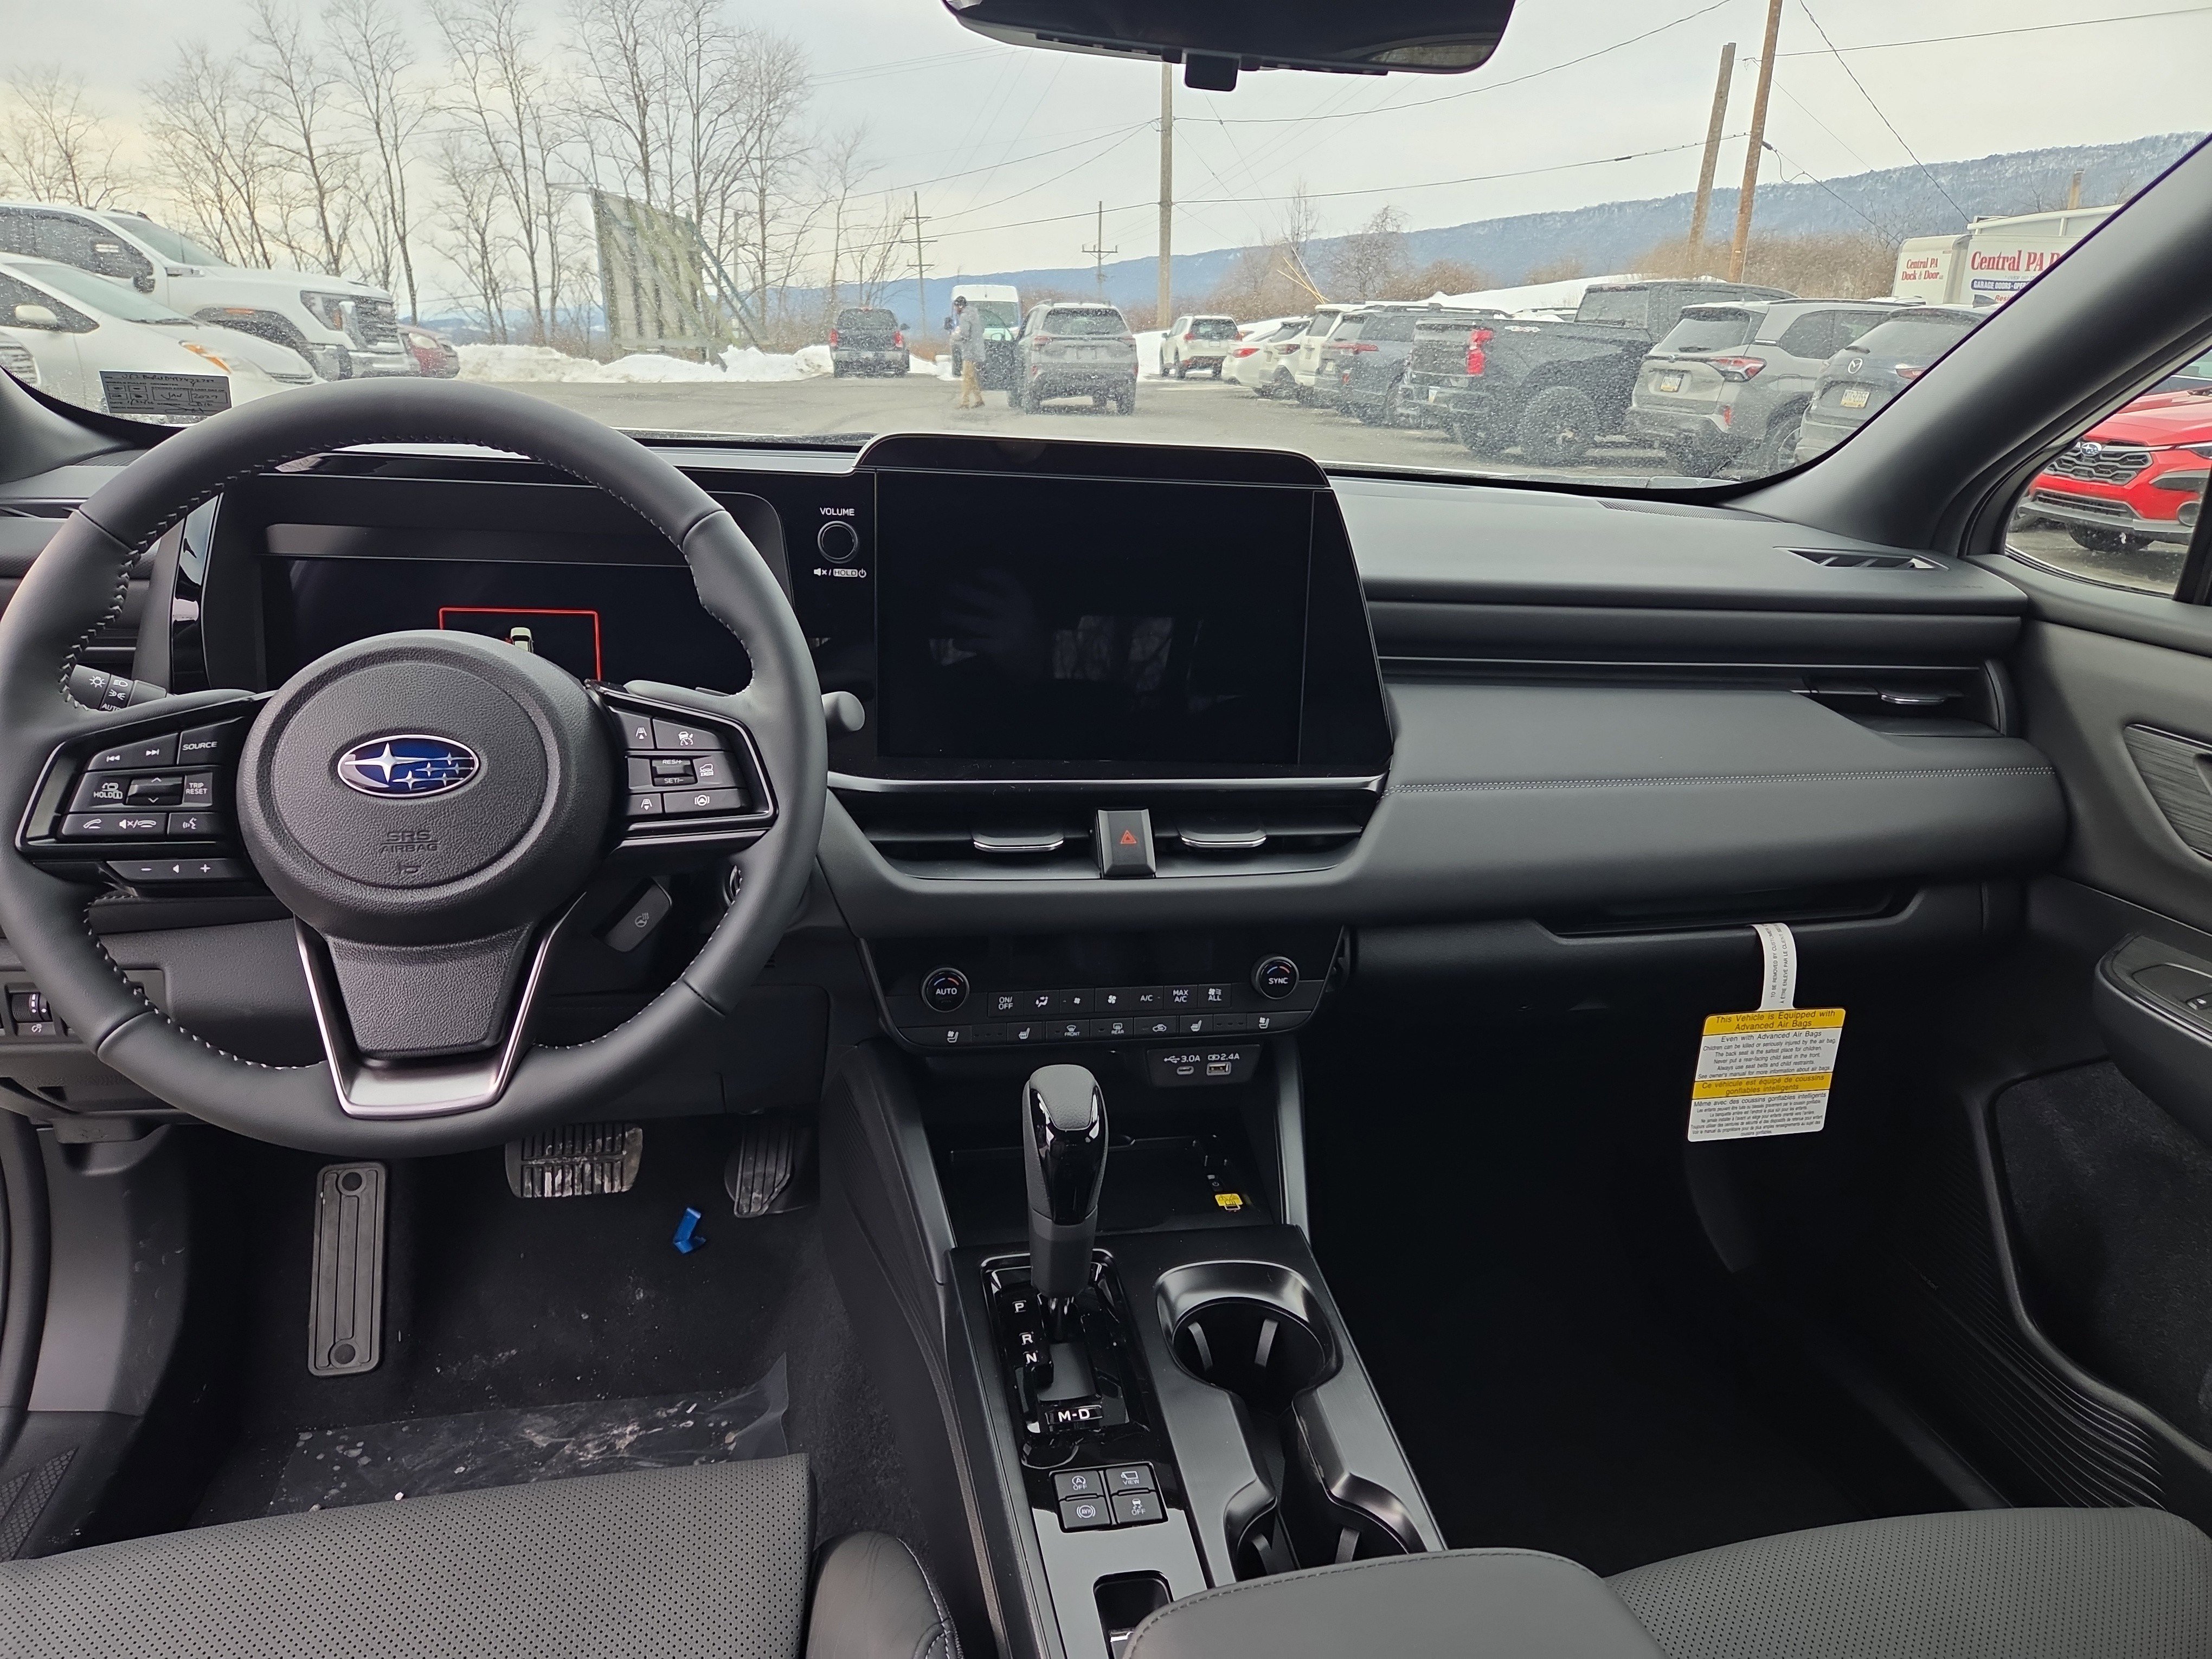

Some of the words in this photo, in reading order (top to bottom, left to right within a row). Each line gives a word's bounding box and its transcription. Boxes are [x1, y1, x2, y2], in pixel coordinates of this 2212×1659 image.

[1906, 258, 1928, 268] Central
[1971, 250, 2022, 271] Central
[2025, 252, 2044, 272] PA
[1901, 270, 1917, 280] Dock
[1924, 271, 1939, 279] Door
[1973, 280, 1994, 289] GARAGE
[820, 507, 855, 516] VOLUME
[182, 741, 218, 751] SOURCE
[387, 831, 433, 841] SRS
[381, 844, 438, 853] AIRBAG
[936, 987, 957, 995] AUTO
[1736, 1014, 1764, 1023] Vehicle
[1778, 1011, 1816, 1020] Equipped
[1735, 1022, 1774, 1031] Advanced
[1792, 1019, 1812, 1028] Bags
[1757, 1031, 1790, 1040] Advanced
[1181, 1054, 1200, 1063] 3.0A
[1726, 1086, 1760, 1096] gonflables
[1763, 1084, 1799, 1092] intelligents
[1768, 1094, 1796, 1103] gonflables
[1797, 1091, 1827, 1100] intelligents
[1014, 1302, 1024, 1313] P
[1022, 1334, 1033, 1345] R
[1026, 1352, 1037, 1364] N
[1058, 1409, 1090, 1422] M-D
